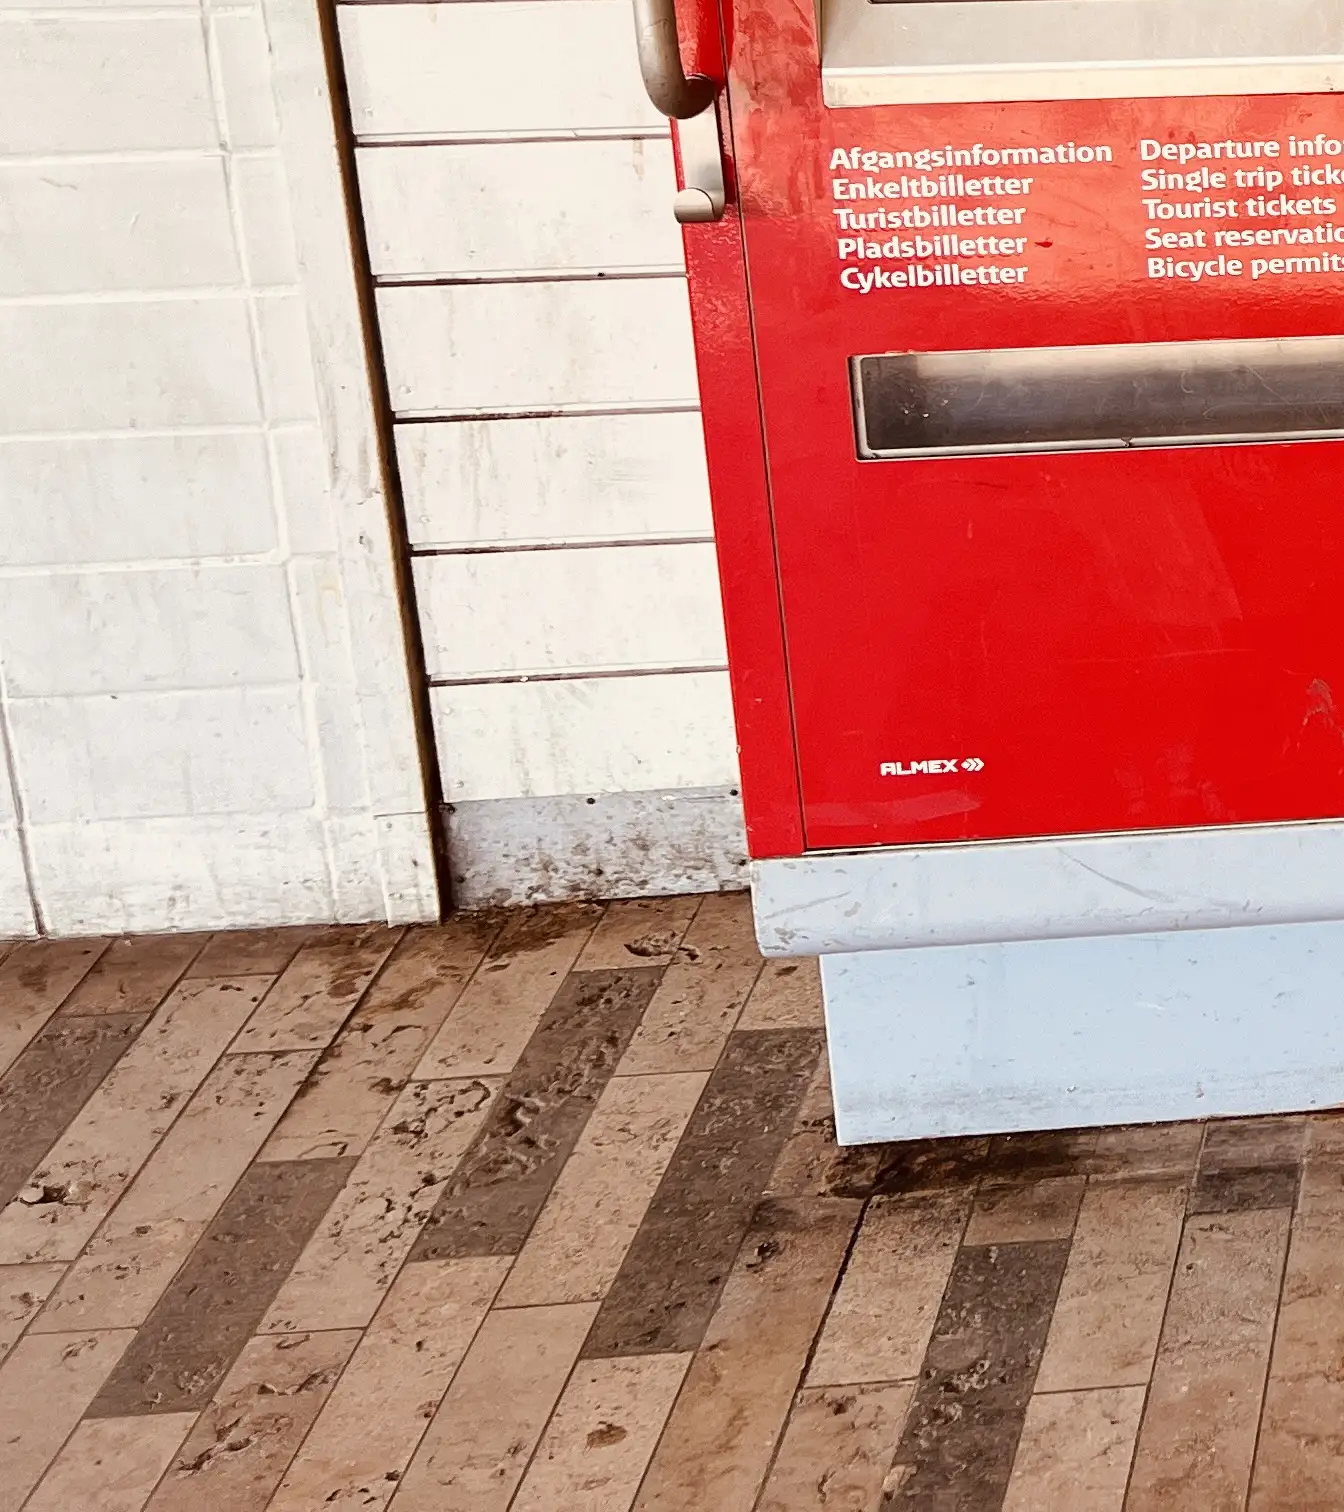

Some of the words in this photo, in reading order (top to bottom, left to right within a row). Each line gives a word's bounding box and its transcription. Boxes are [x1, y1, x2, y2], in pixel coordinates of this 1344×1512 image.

[830, 141, 1112, 173] Afgangsinformation
[1140, 137, 1280, 166] Departure
[833, 174, 1033, 200] Enkeltbilletter
[1140, 166, 1227, 195] Single
[1234, 165, 1284, 194] trip
[833, 203, 1026, 229] Turistbilletter
[1143, 196, 1239, 220] Tourist
[1245, 194, 1337, 218] tickets
[838, 233, 1027, 259] Pladsbilletter
[1145, 226, 1207, 251] Seat
[840, 263, 1028, 293] Cykelbilletter
[1147, 254, 1242, 283] Bicycle
[880, 759, 959, 776] ALMEX
